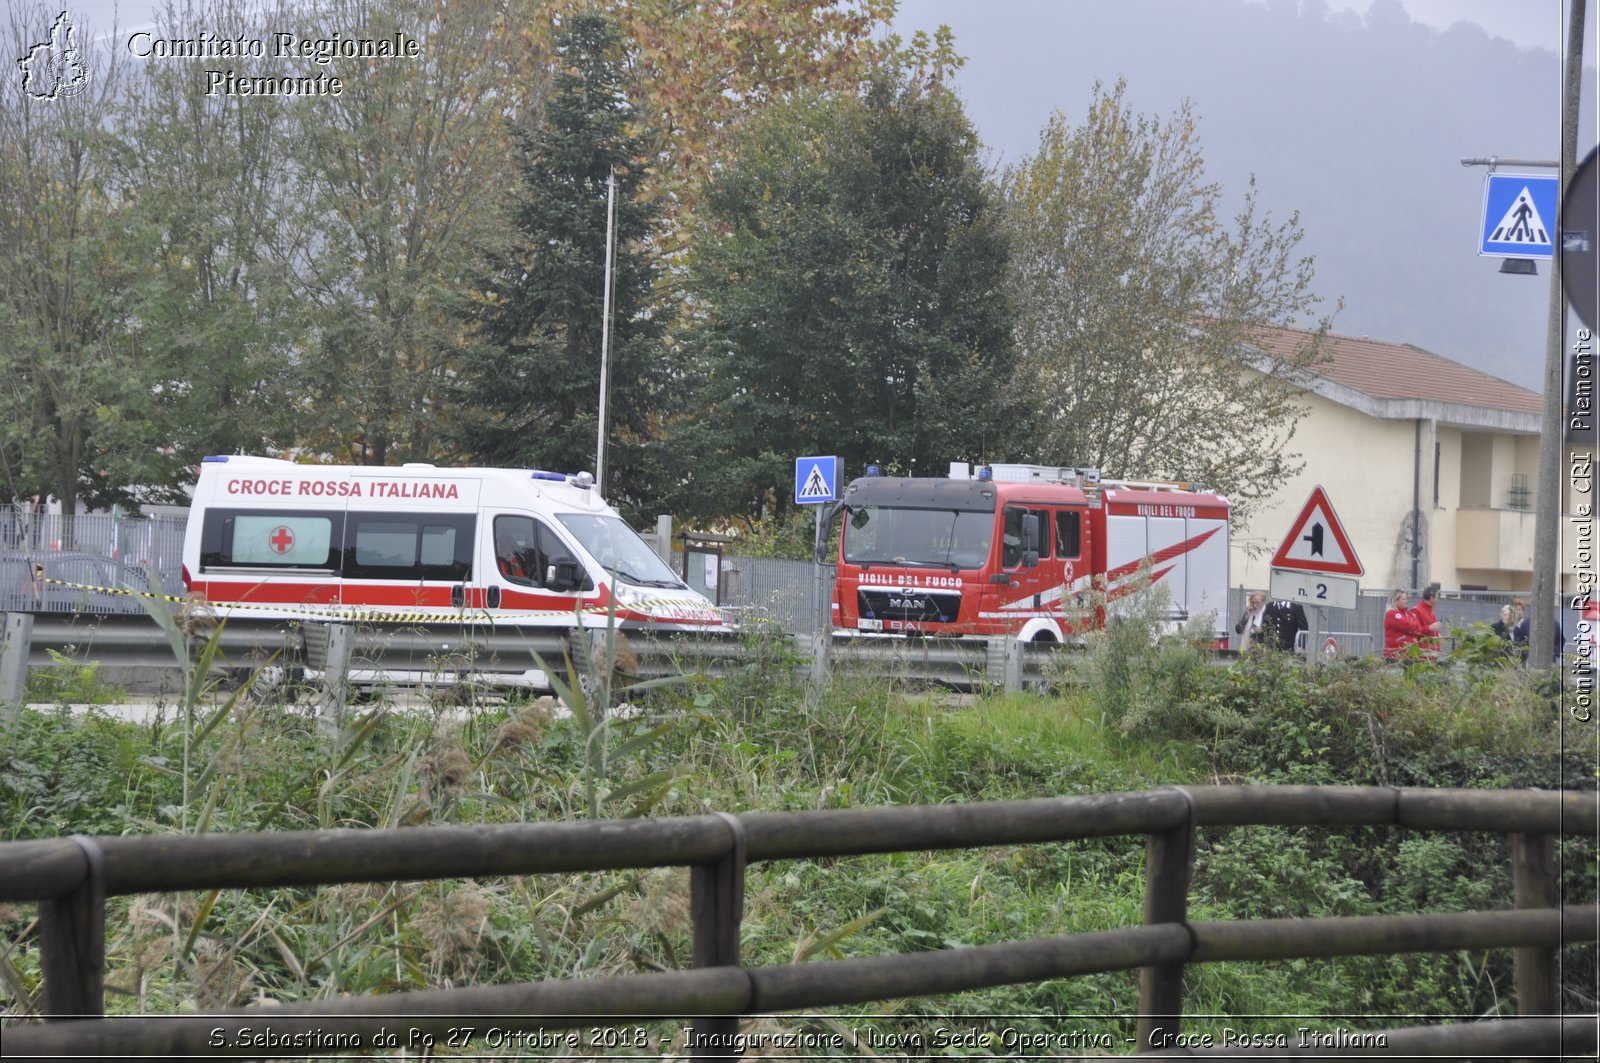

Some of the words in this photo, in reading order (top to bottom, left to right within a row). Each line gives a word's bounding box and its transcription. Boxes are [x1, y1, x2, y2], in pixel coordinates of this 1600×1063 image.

[227, 479, 293, 496] CROCE
[299, 480, 363, 498] ROSSA
[369, 481, 458, 500] ITALIANA
[1137, 504, 1159, 516] VIGILI
[1160, 505, 1173, 517] DEL
[1175, 506, 1196, 518] FUOCO
[858, 573, 893, 585] VIGILI
[897, 575, 919, 586] DEL
[925, 576, 962, 588] FUOCO
[1298, 587, 1308, 597] n.
[1315, 583, 1327, 599] 2
[889, 599, 925, 609] MAN
